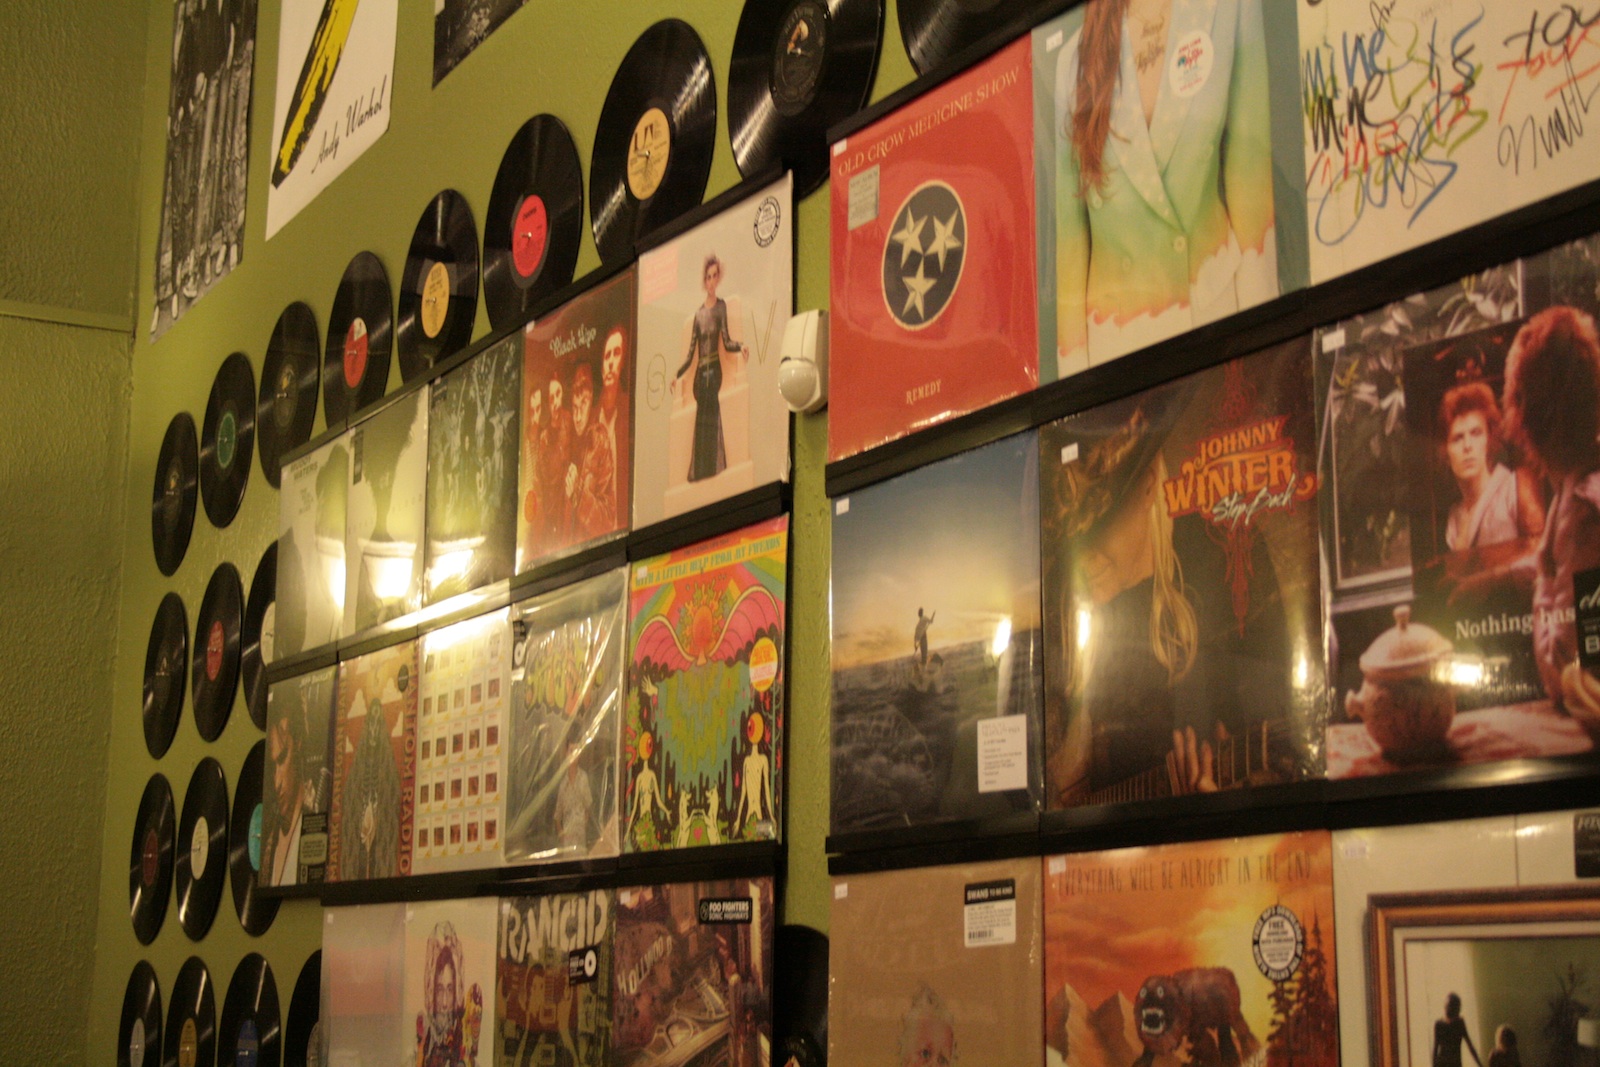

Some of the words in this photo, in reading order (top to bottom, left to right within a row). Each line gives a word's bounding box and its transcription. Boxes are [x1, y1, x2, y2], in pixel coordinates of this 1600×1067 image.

[311, 121, 339, 173] Andy
[346, 74, 387, 137] Warhol
[838, 150, 865, 176] OLD
[867, 128, 906, 162] CROW
[908, 92, 973, 142] MEDICINE
[976, 66, 1019, 103] SHOW
[906, 379, 942, 405] REMEDY
[1194, 420, 1280, 470] JOHNNY
[1165, 449, 1300, 514] WINTER
[1455, 613, 1533, 639] Nothing
[1540, 607, 1576, 625] has
[332, 725, 345, 817] LANEGAN
[328, 824, 340, 880] MARK
[399, 787, 413, 875] RADIO
[1129, 862, 1154, 891] WILL
[1161, 860, 1173, 889] BE
[1180, 857, 1230, 889] ALRIGHT
[1238, 855, 1250, 884] IN
[1258, 852, 1279, 883] THE
[1287, 850, 1311, 882] END
[500, 889, 608, 963] RANCID
[709, 901, 722, 912] FOO
[722, 900, 749, 912] FIGHTERS
